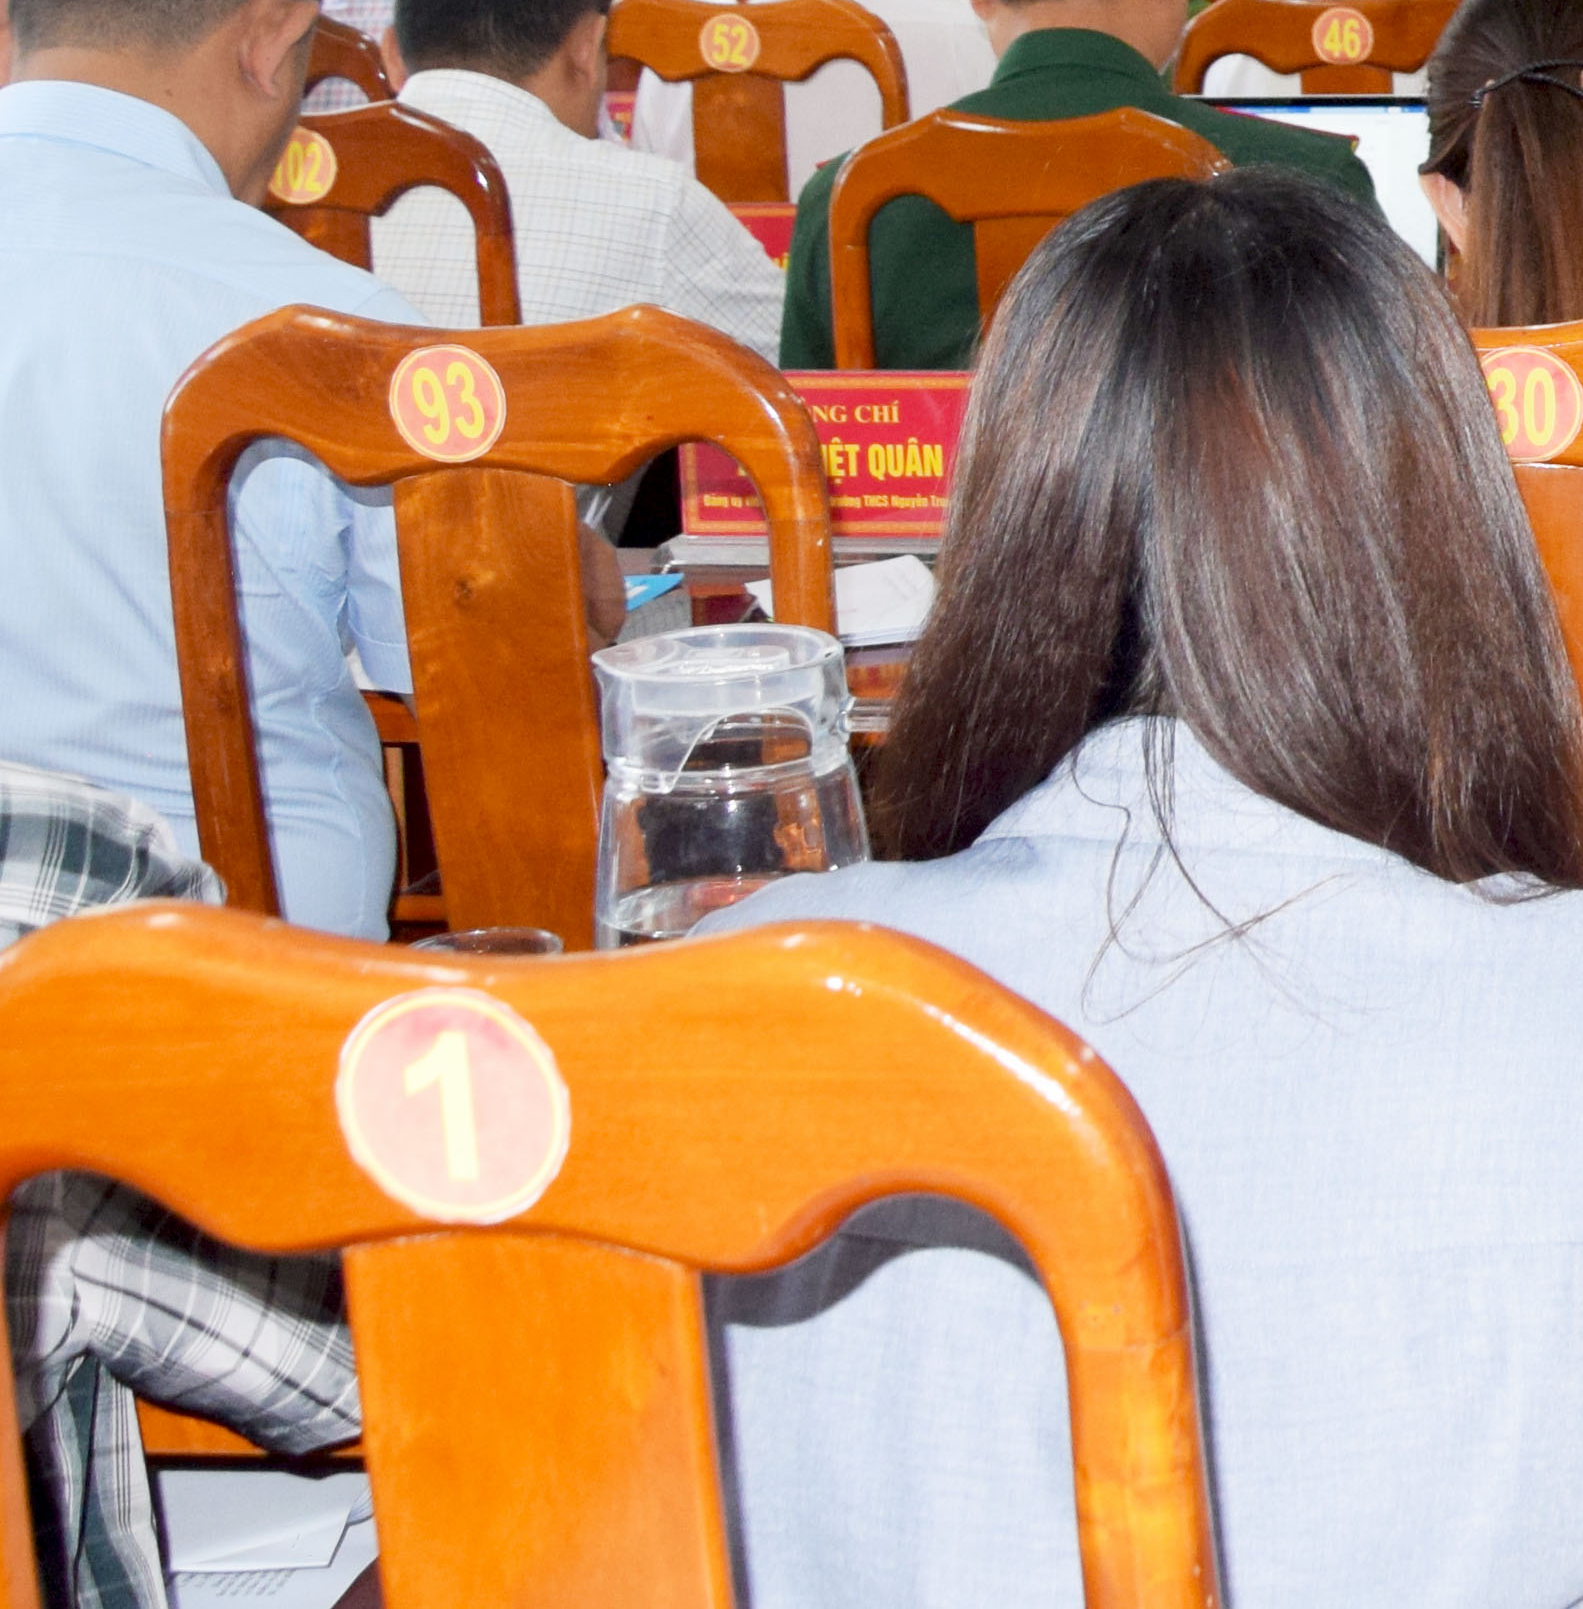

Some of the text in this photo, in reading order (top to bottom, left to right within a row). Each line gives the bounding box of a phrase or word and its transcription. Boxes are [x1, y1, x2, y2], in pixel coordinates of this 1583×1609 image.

[712, 25, 749, 69] 52
[1323, 17, 1362, 58] 46
[411, 361, 486, 445] 93
[811, 400, 899, 423] NG CHÍ
[1487, 366, 1556, 446] 30
[868, 437, 944, 480] QUÂN
[864, 495, 888, 507] THCS
[404, 1031, 478, 1183] 1
